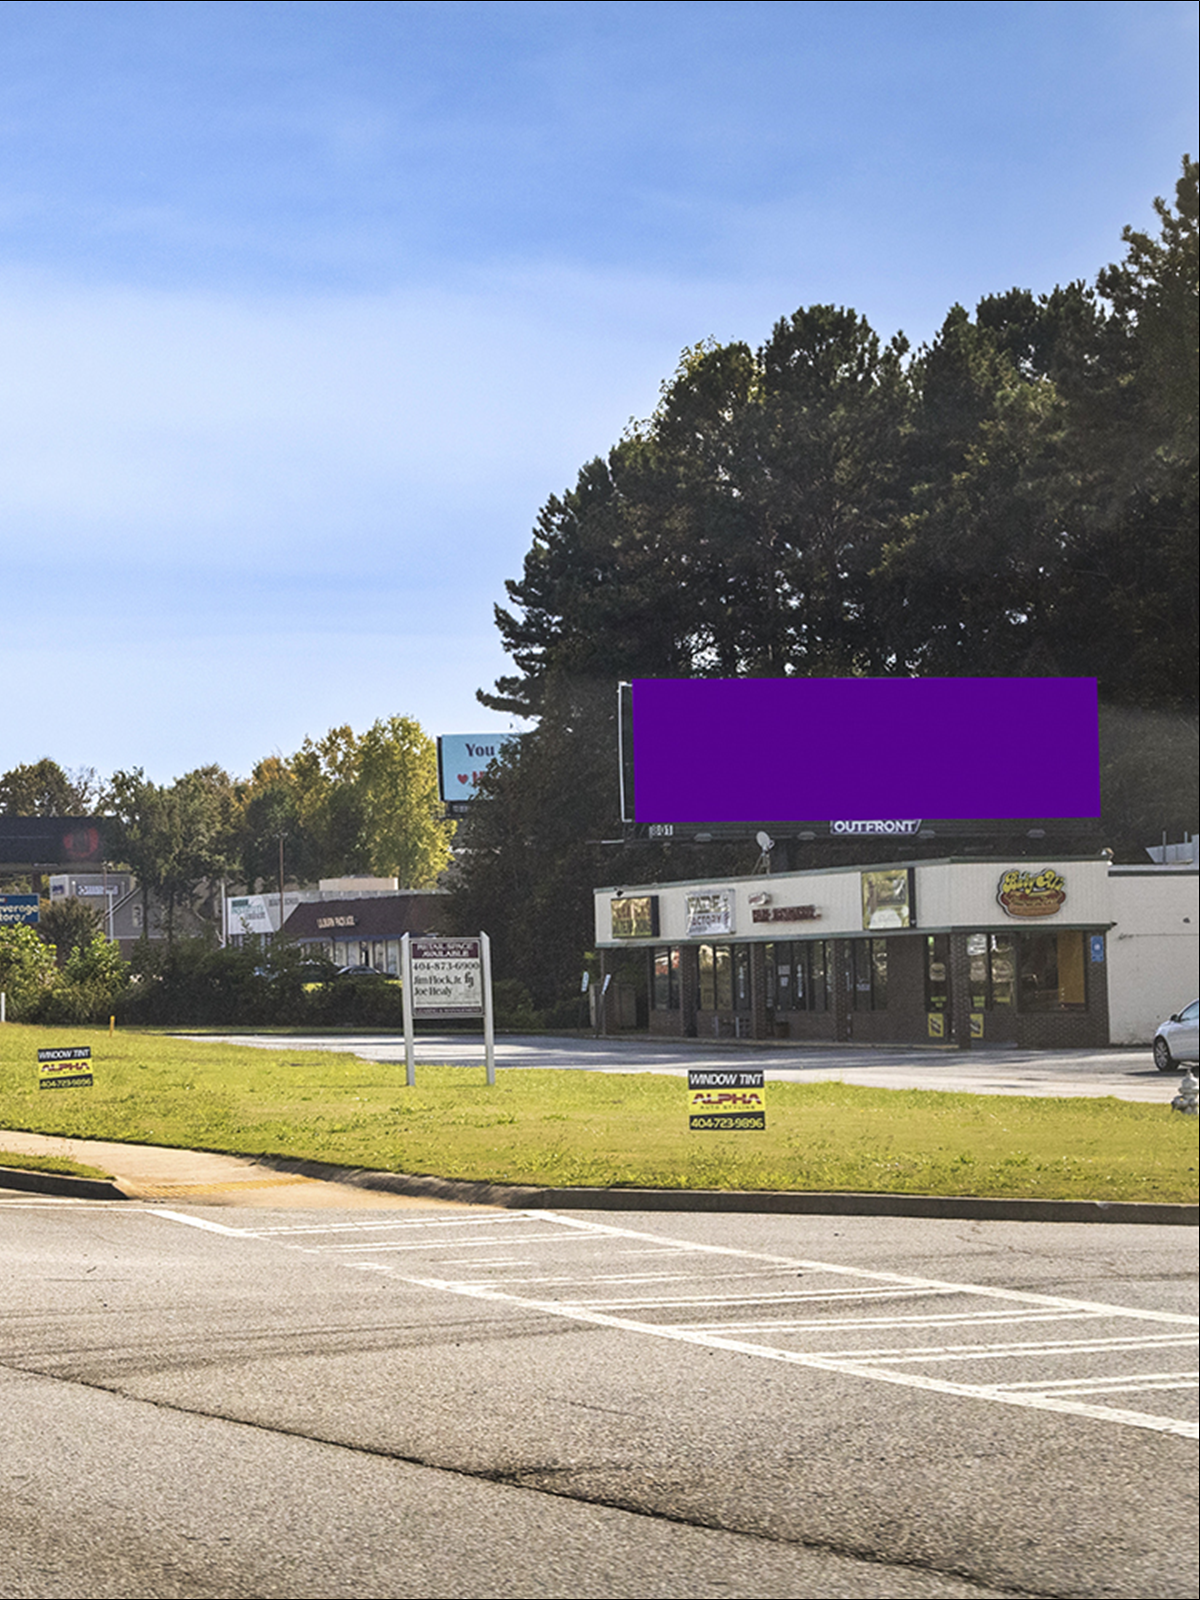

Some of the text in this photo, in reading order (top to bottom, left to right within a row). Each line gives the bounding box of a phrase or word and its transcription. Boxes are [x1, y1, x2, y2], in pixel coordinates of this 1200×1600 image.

[465, 743, 495, 757] You
[834, 820, 916, 832] OUTFRONT
[413, 962, 480, 970] 404-873-6900
[39, 1049, 90, 1059] WINDOW TINT
[41, 1062, 90, 1072] ALPHA
[689, 1074, 762, 1085] WINDOW TINT
[692, 1093, 762, 1104] ALPHA
